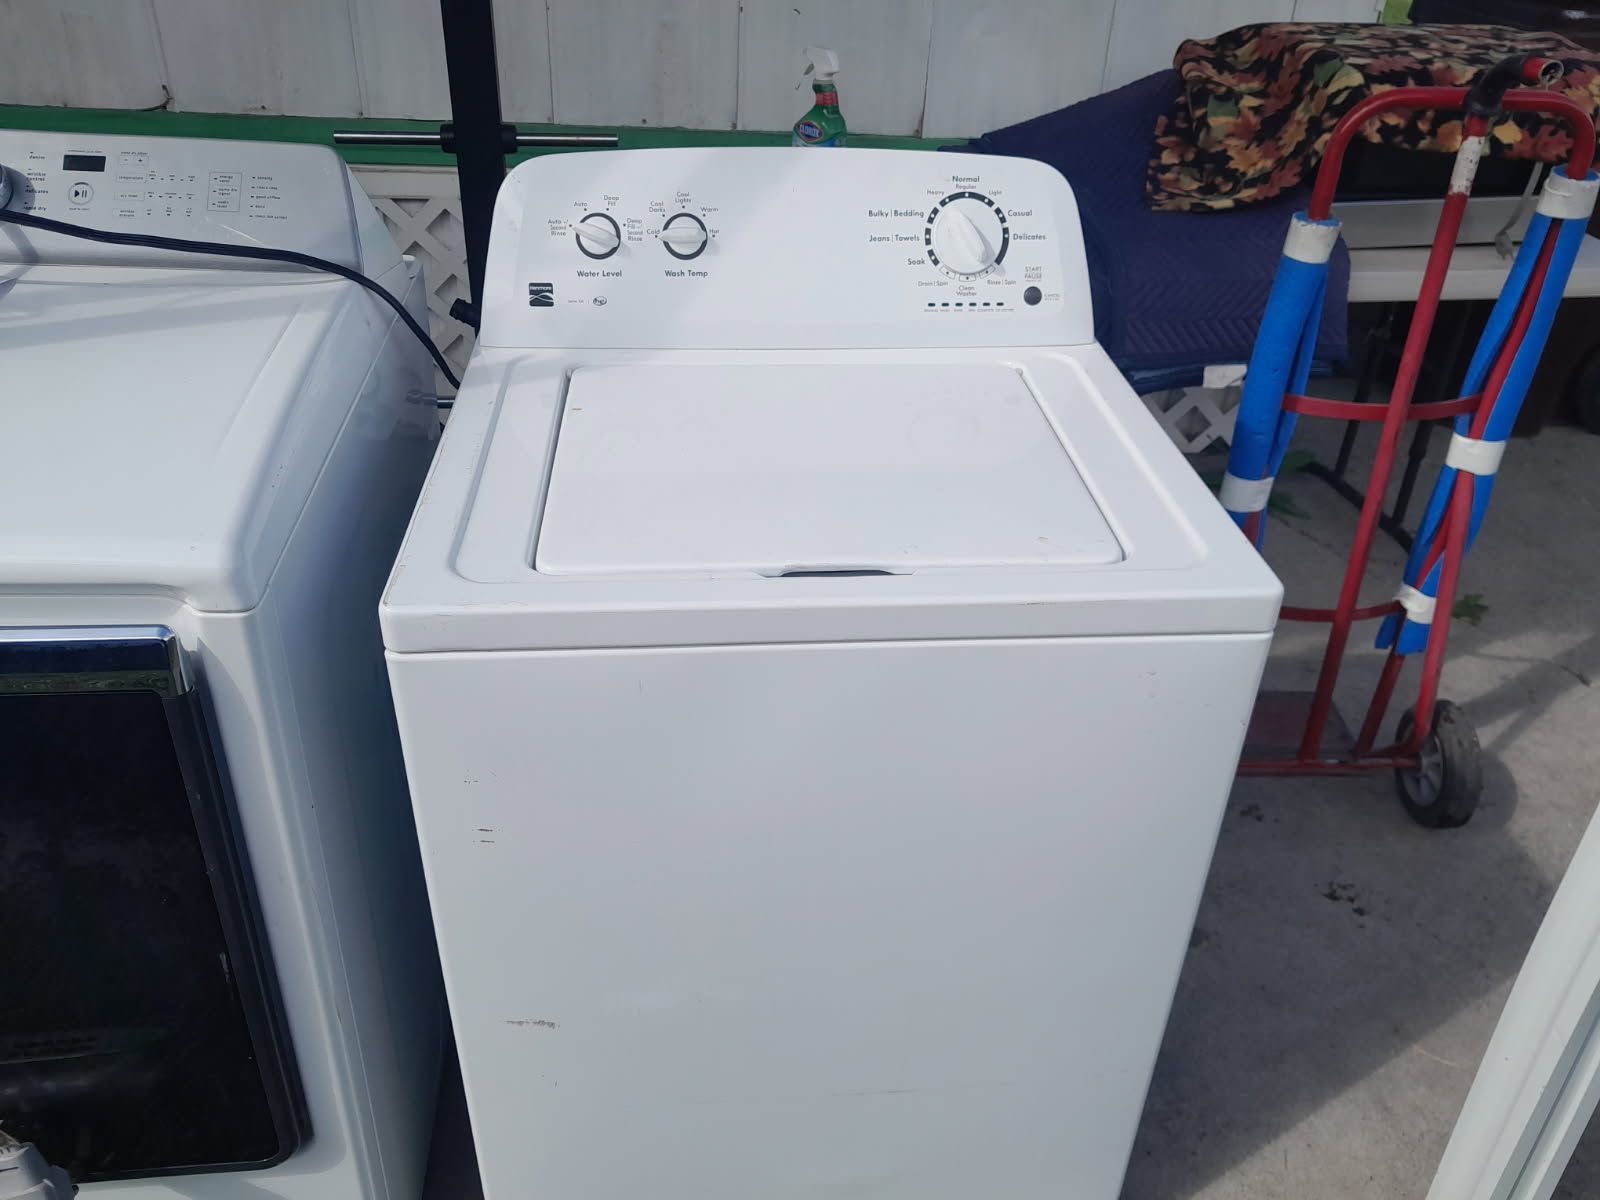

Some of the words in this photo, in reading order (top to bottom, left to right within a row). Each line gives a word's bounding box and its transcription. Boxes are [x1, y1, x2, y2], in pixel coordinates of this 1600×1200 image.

[952, 175, 980, 183] Normal
[868, 210, 889, 218] Bulky
[893, 210, 925, 218] Bedding
[576, 270, 600, 278] Water
[602, 270, 623, 278] Level
[664, 270, 685, 278] Wash
[688, 270, 709, 279] Temp
